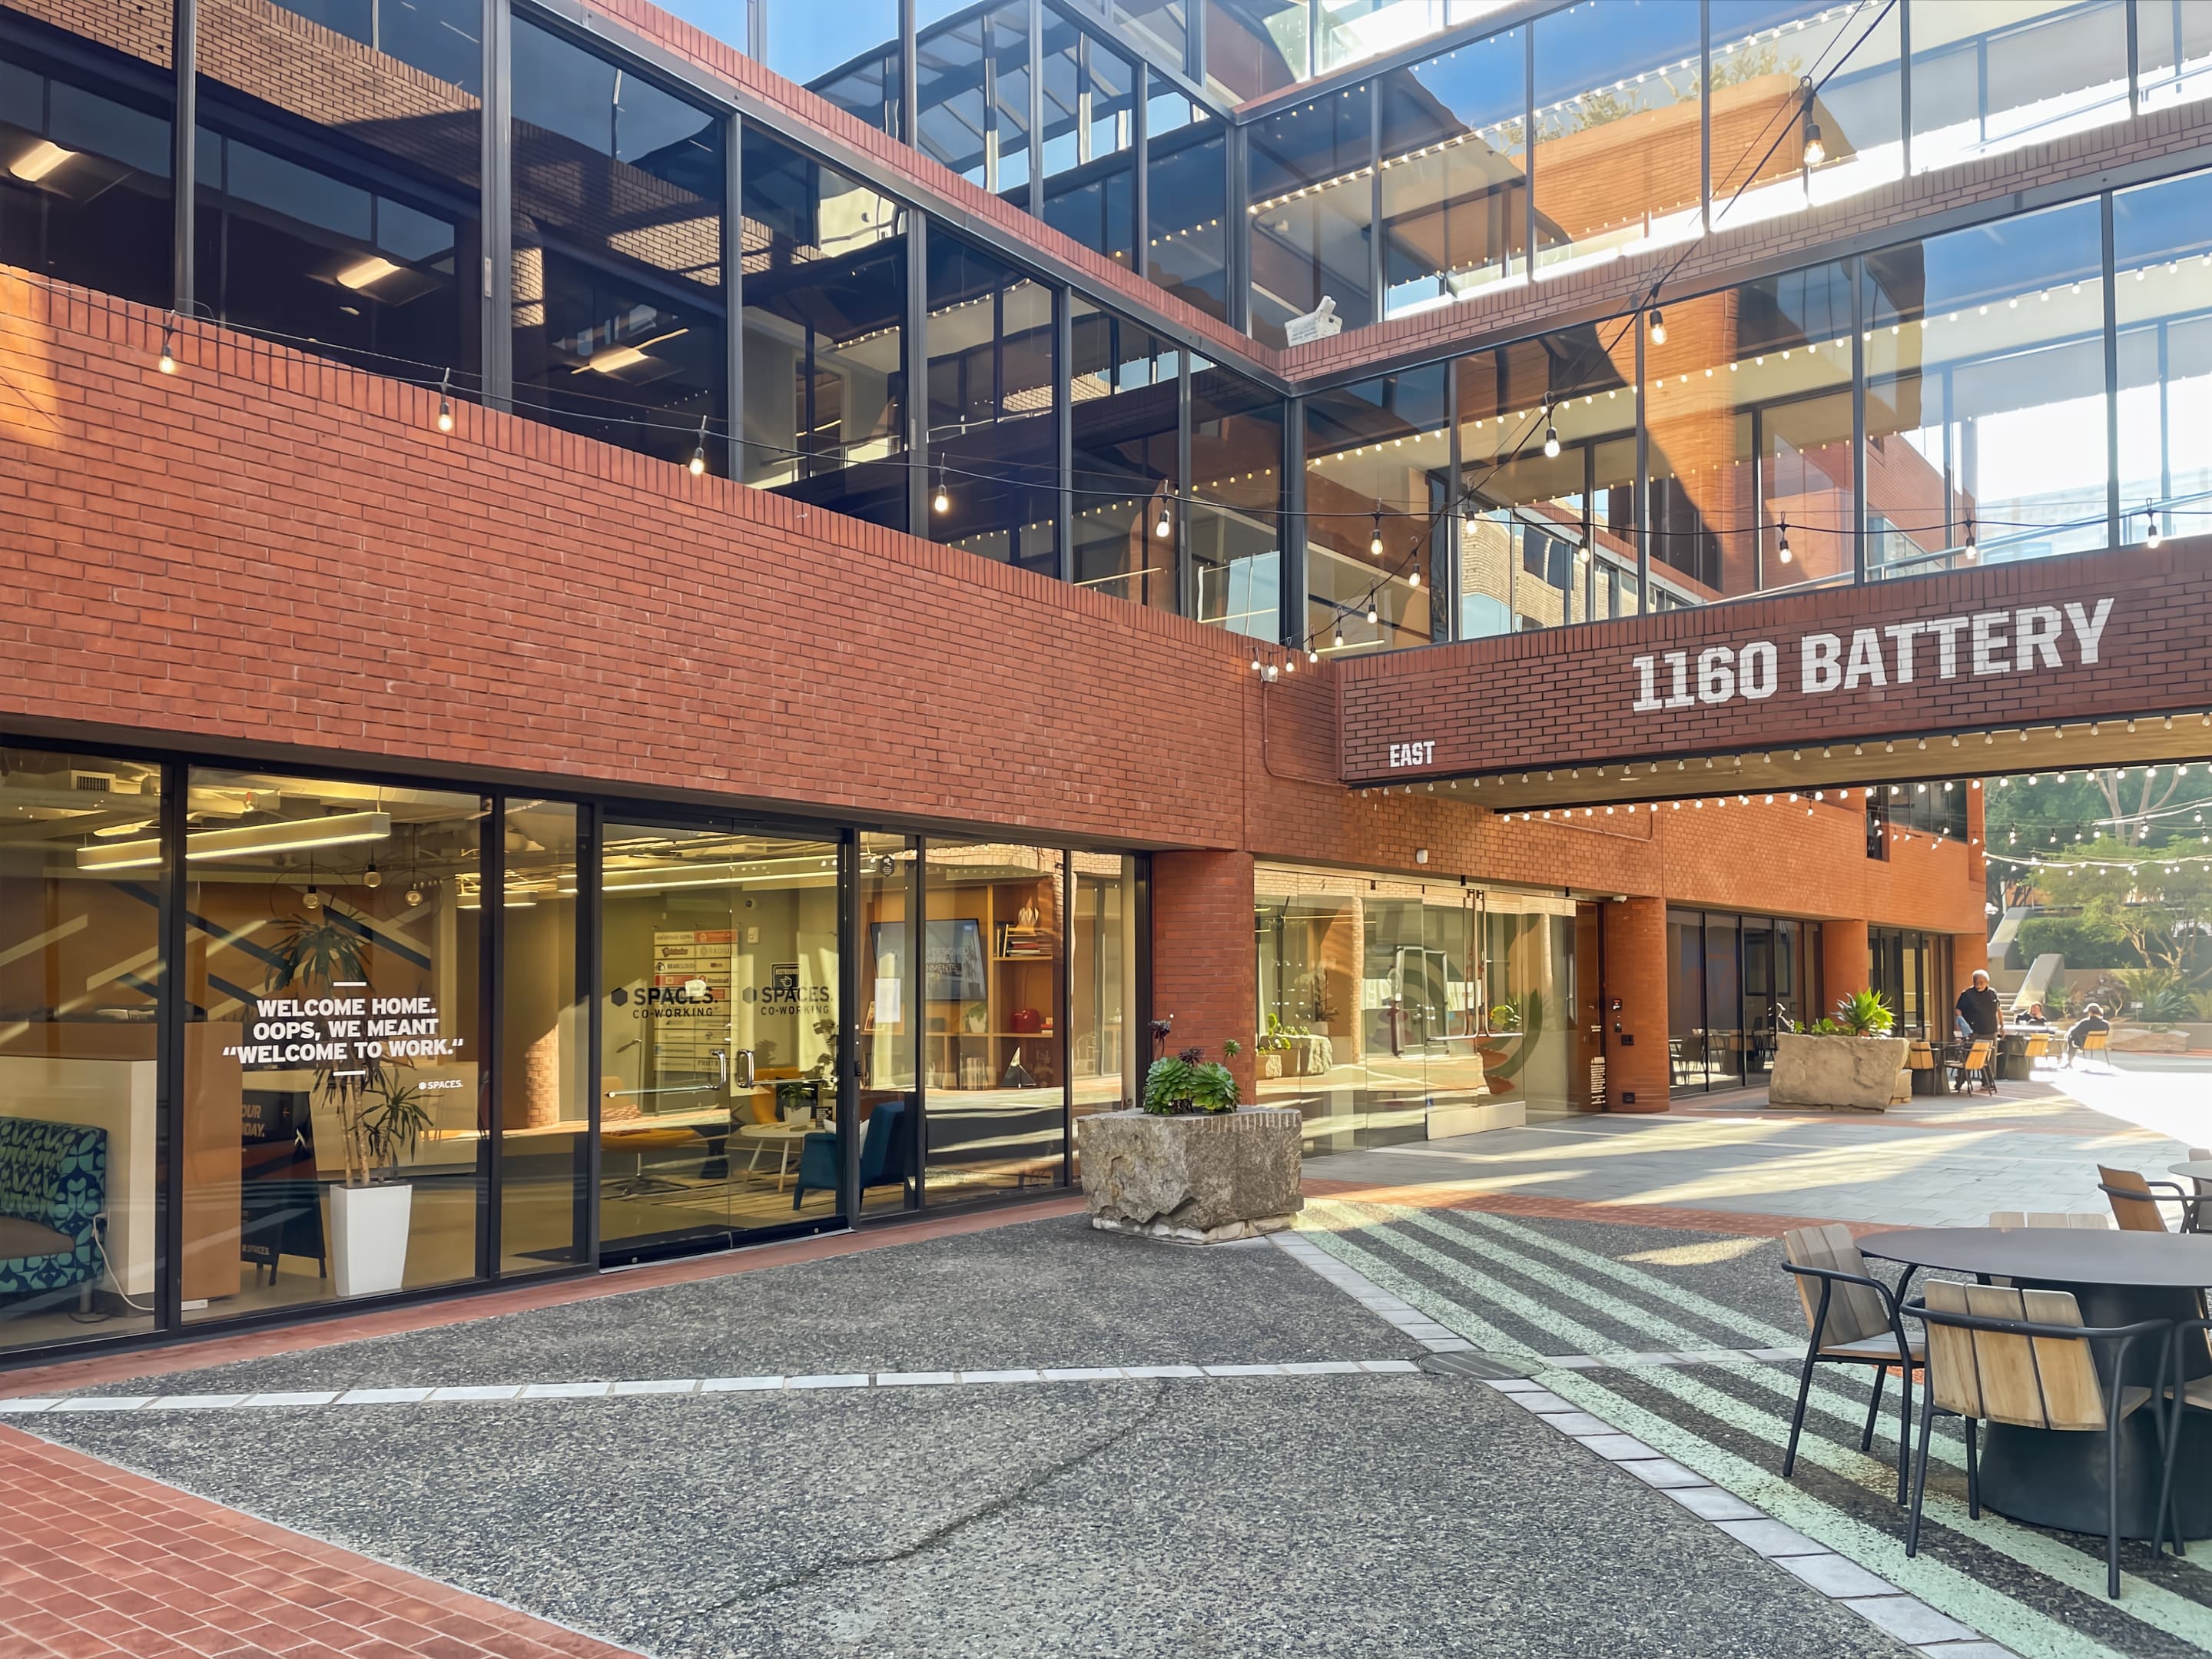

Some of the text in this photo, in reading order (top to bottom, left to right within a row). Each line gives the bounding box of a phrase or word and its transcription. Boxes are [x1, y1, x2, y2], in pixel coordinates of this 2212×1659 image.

[1632, 597, 2116, 712] 1160 BATTERY
[1389, 740, 1436, 768] EAST
[761, 986, 834, 1004] SPACES.
[256, 997, 437, 1018] WELCOME HOME.
[632, 1007, 713, 1019] CO-WORKING
[761, 1005, 830, 1016] CO-WORKING
[253, 1018, 439, 1041] OOPS, WE MEANT
[353, 1041, 383, 1060] TO
[427, 1080, 465, 1090] SPACES.
[242, 1123, 265, 1138] DAY.
